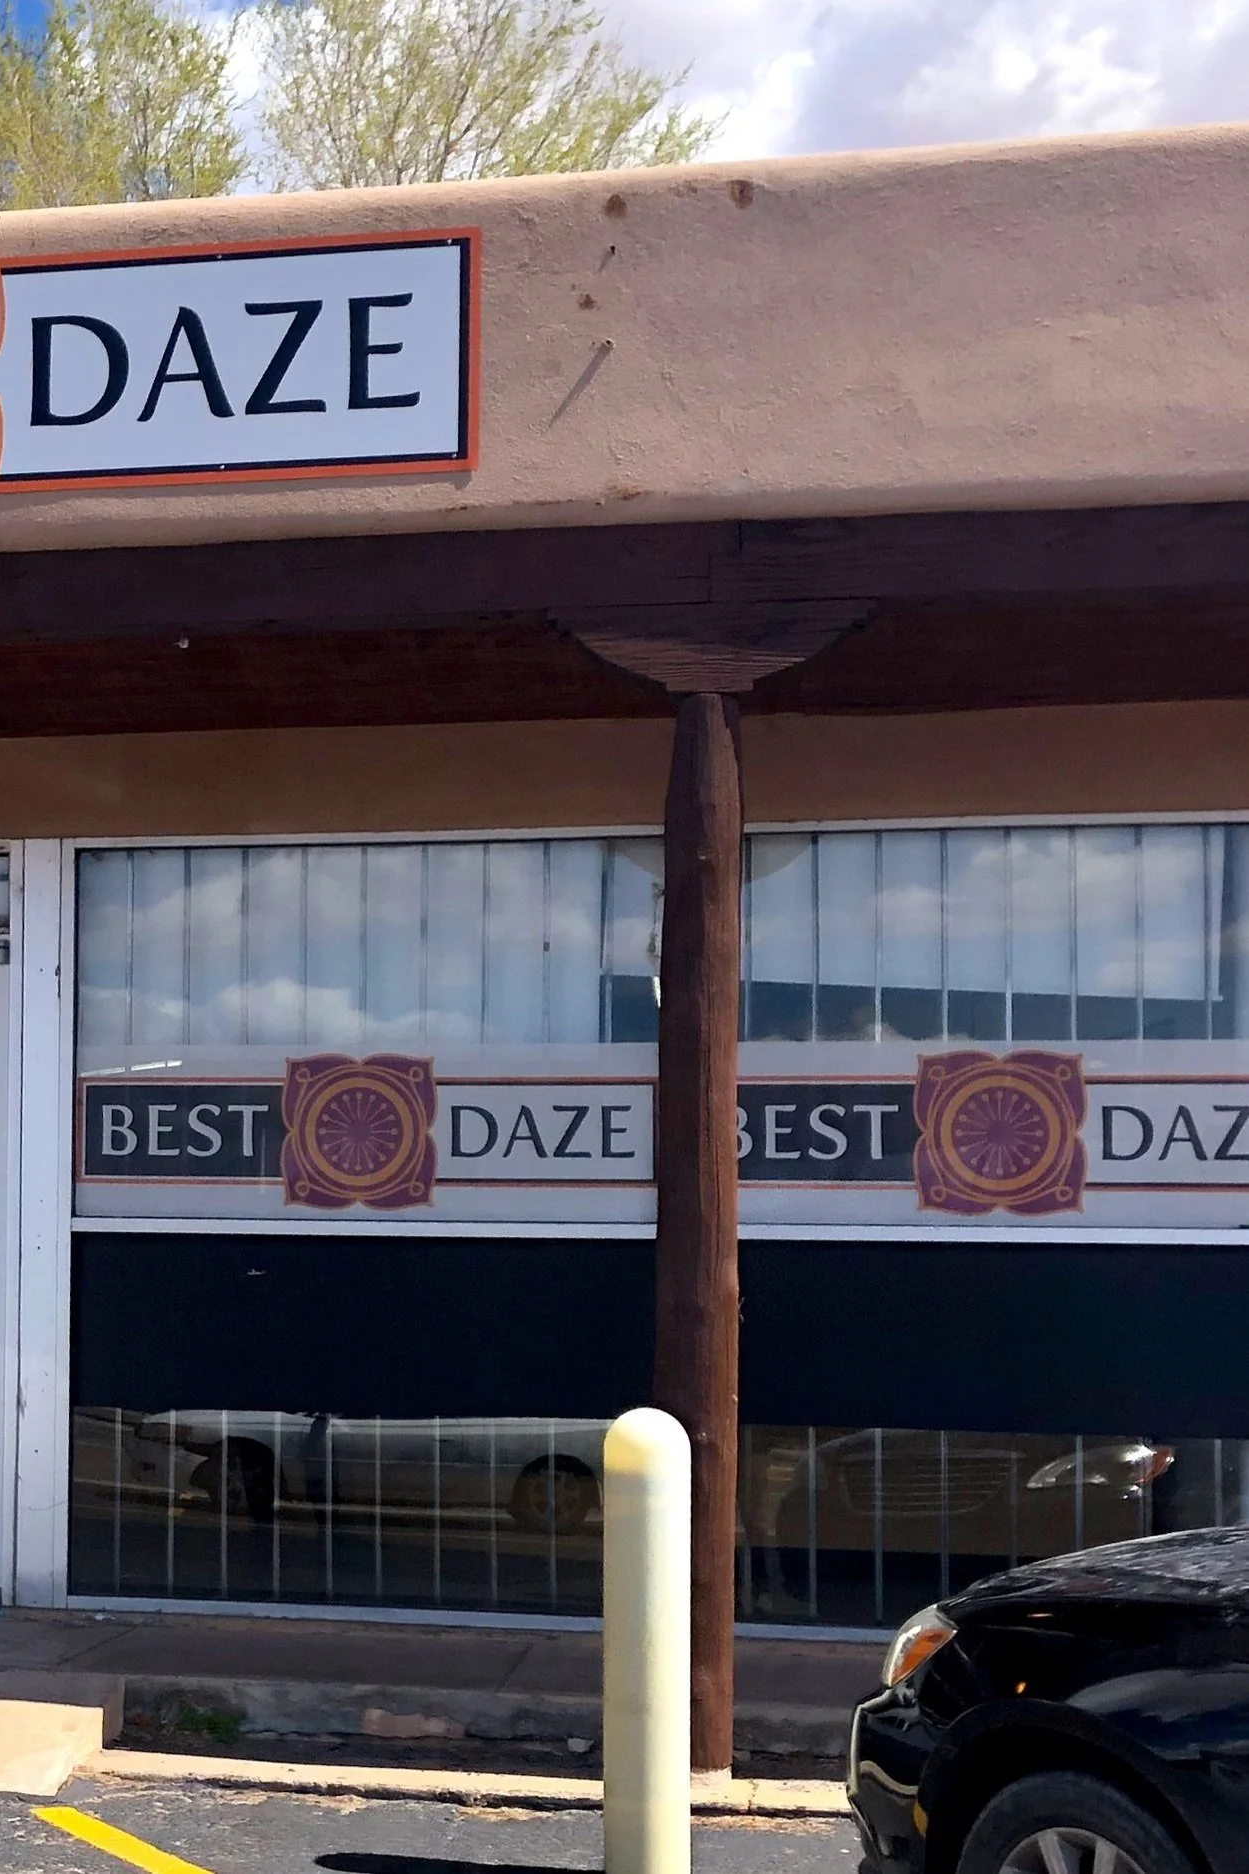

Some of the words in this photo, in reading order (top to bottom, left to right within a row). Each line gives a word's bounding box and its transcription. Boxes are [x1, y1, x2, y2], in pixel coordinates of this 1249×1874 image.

[30, 293, 420, 426] DAZE
[100, 1103, 268, 1158] BEST
[450, 1105, 636, 1158] DAZE
[1102, 1105, 1249, 1160] DAZ
